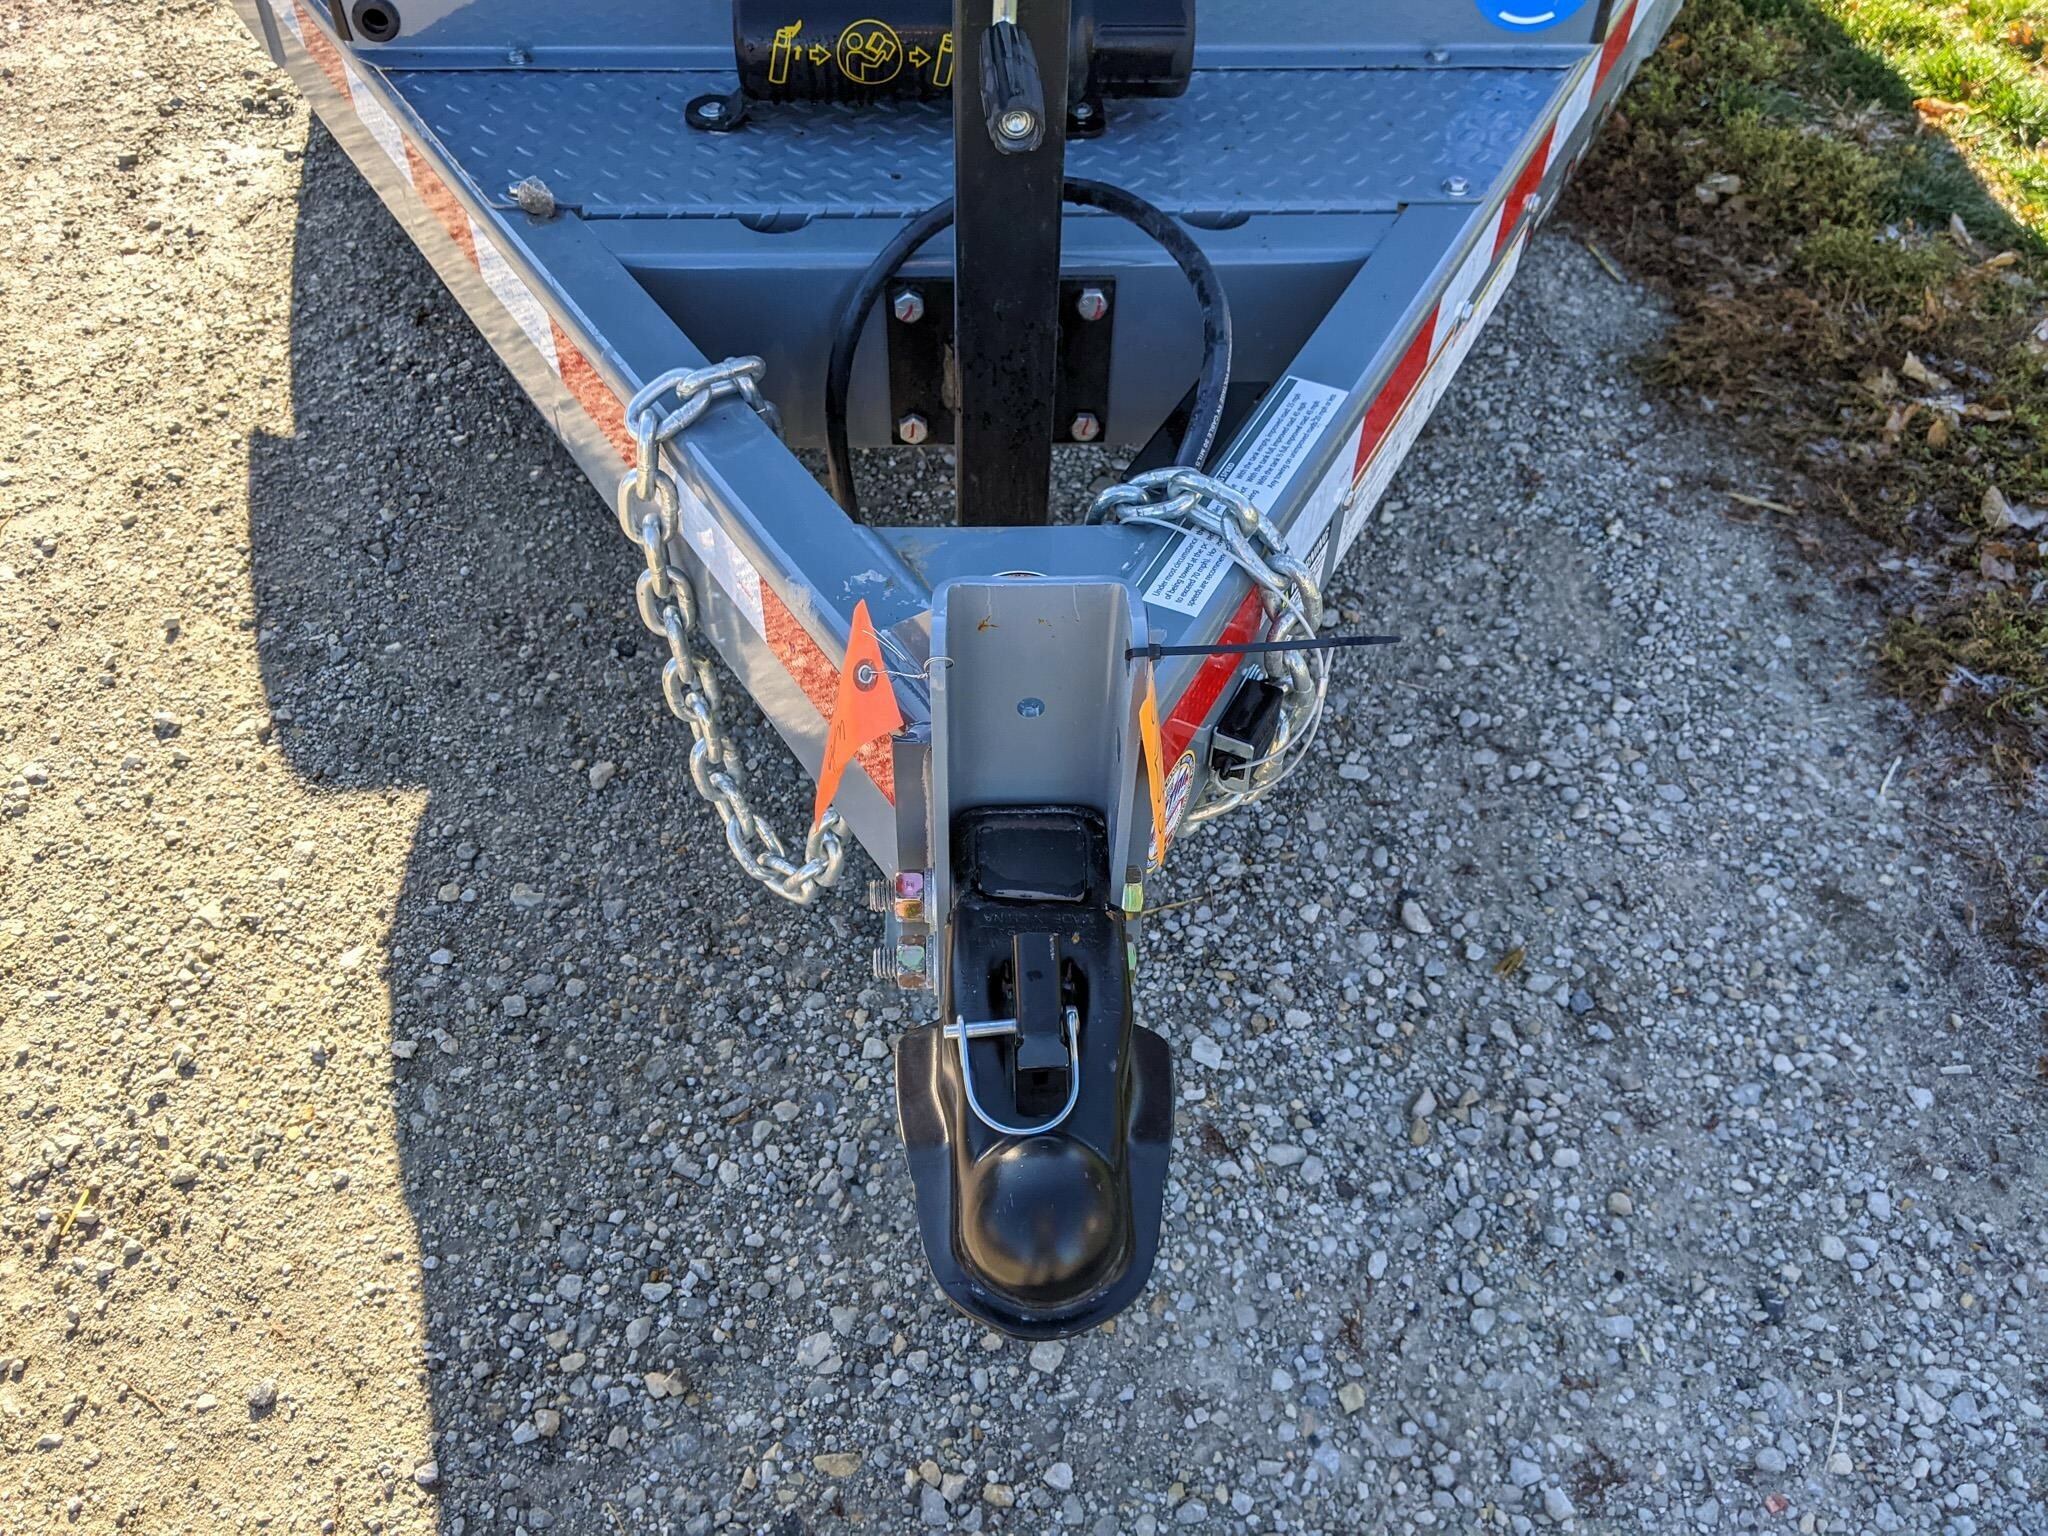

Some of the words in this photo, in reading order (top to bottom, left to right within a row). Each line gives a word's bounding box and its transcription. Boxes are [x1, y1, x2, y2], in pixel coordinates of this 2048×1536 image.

[1151, 579, 1168, 597] Under
[1164, 566, 1177, 581] most
[1167, 577, 1184, 594] being
[1178, 562, 1194, 579] towed
[1193, 547, 1204, 558] the
[1179, 577, 1196, 597] exceed
[1191, 571, 1200, 579] 70
[1185, 587, 1203, 607] speeds
